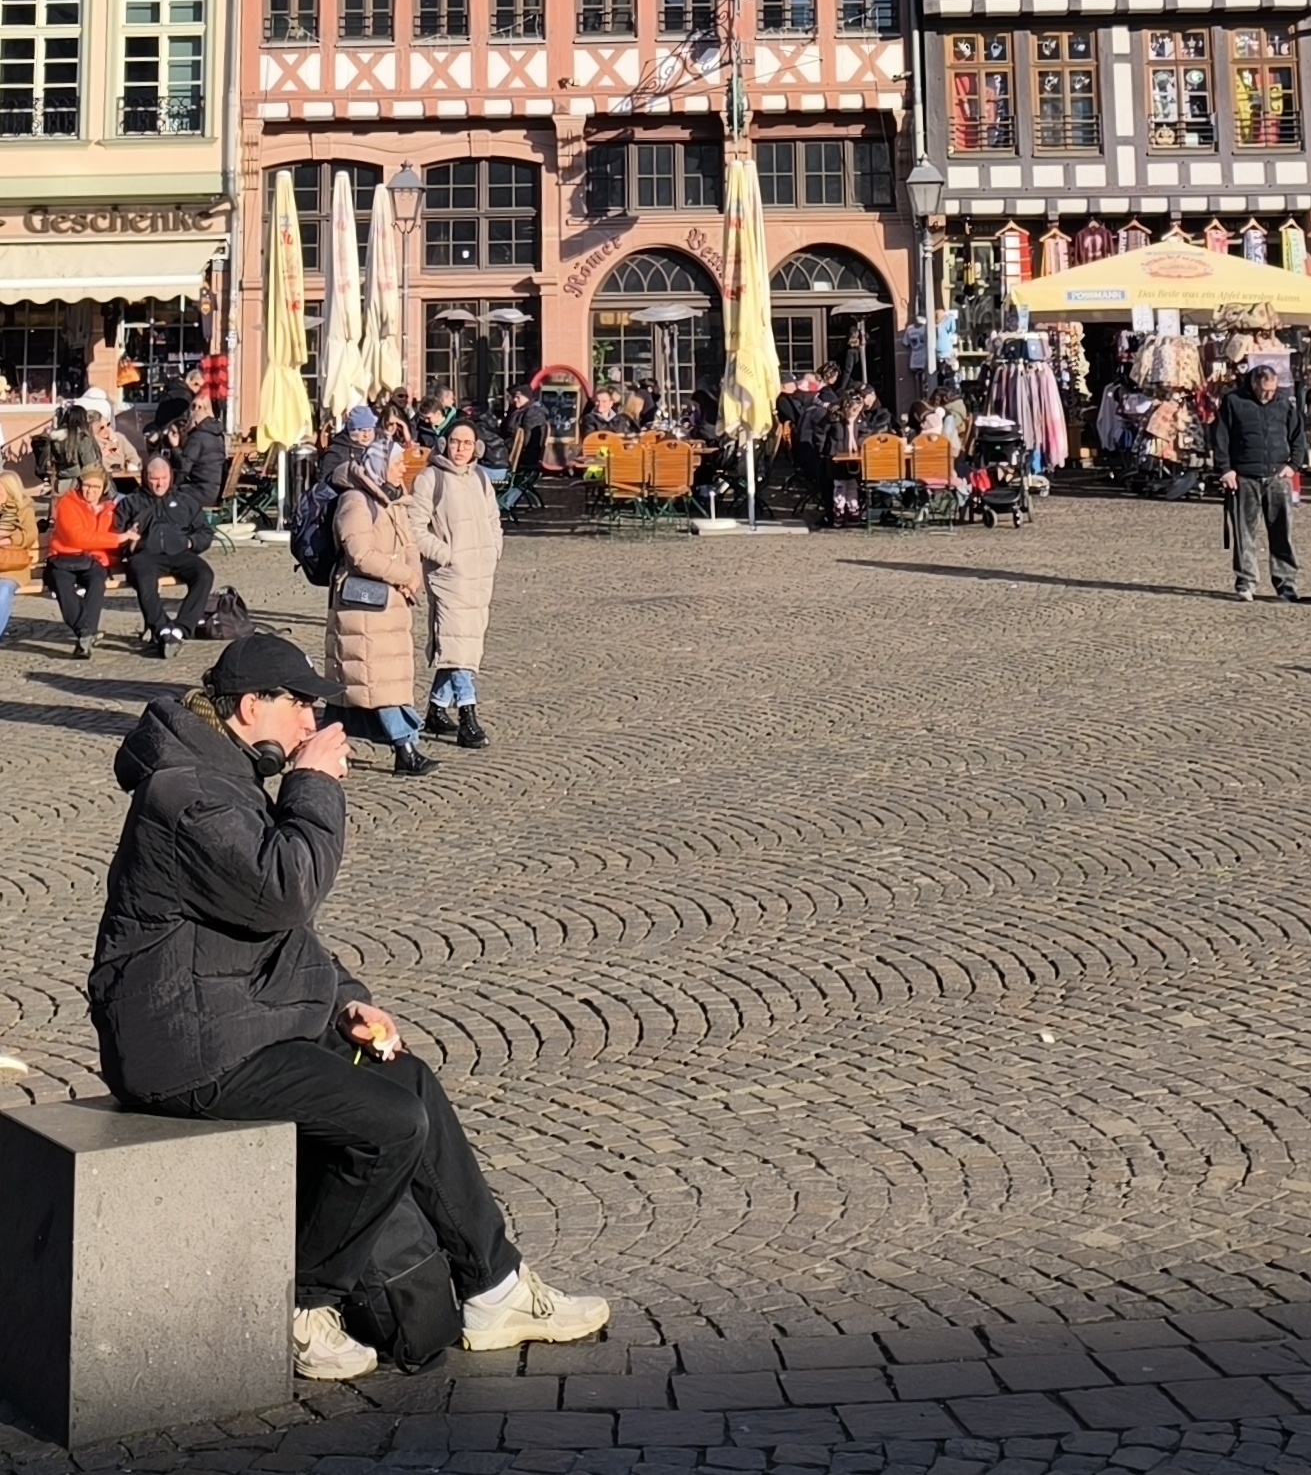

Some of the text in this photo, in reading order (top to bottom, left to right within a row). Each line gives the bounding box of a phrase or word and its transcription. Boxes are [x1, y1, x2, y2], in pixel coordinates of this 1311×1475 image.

[22, 205, 214, 234] Geschenke
[563, 235, 623, 298] Römer
[1070, 290, 1123, 300] POSSMANN
[1137, 289, 1155, 299] Das
[1157, 289, 1179, 299] Beste
[1201, 290, 1215, 299] ein
[1217, 290, 1240, 302] Apfel
